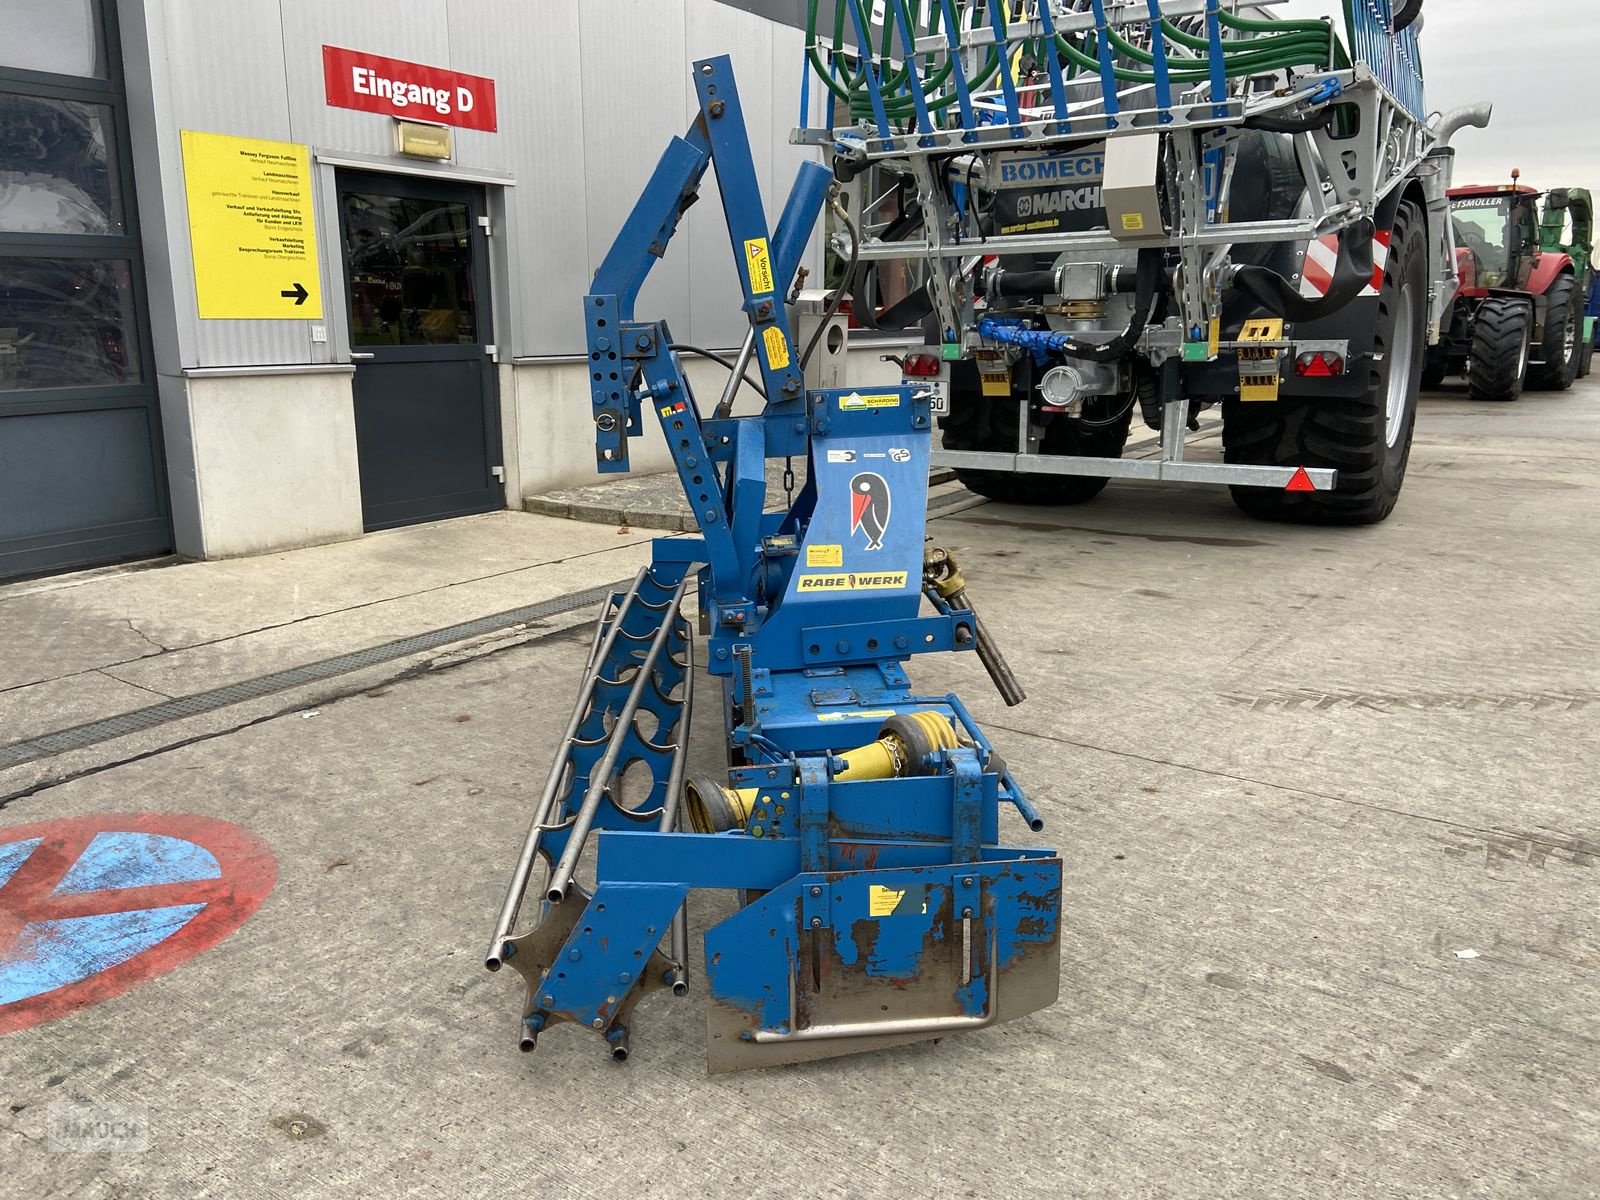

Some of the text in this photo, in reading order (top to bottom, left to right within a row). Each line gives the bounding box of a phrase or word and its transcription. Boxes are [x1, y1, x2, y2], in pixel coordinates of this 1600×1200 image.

[352, 66, 474, 114] Eingang D
[240, 150, 257, 158] Massey
[259, 152, 280, 160] Ferguson
[263, 171, 298, 179] Landmaschinen
[1001, 157, 1105, 182] BOMECH
[243, 211, 270, 219] Anlieferung
[256, 206, 291, 214] Verkaufsleitung
[269, 236, 304, 244] Verkaufsleitung
[760, 257, 771, 290] Vorsicht
[893, 449, 909, 461] GS
[802, 575, 904, 588] RABE WERK
